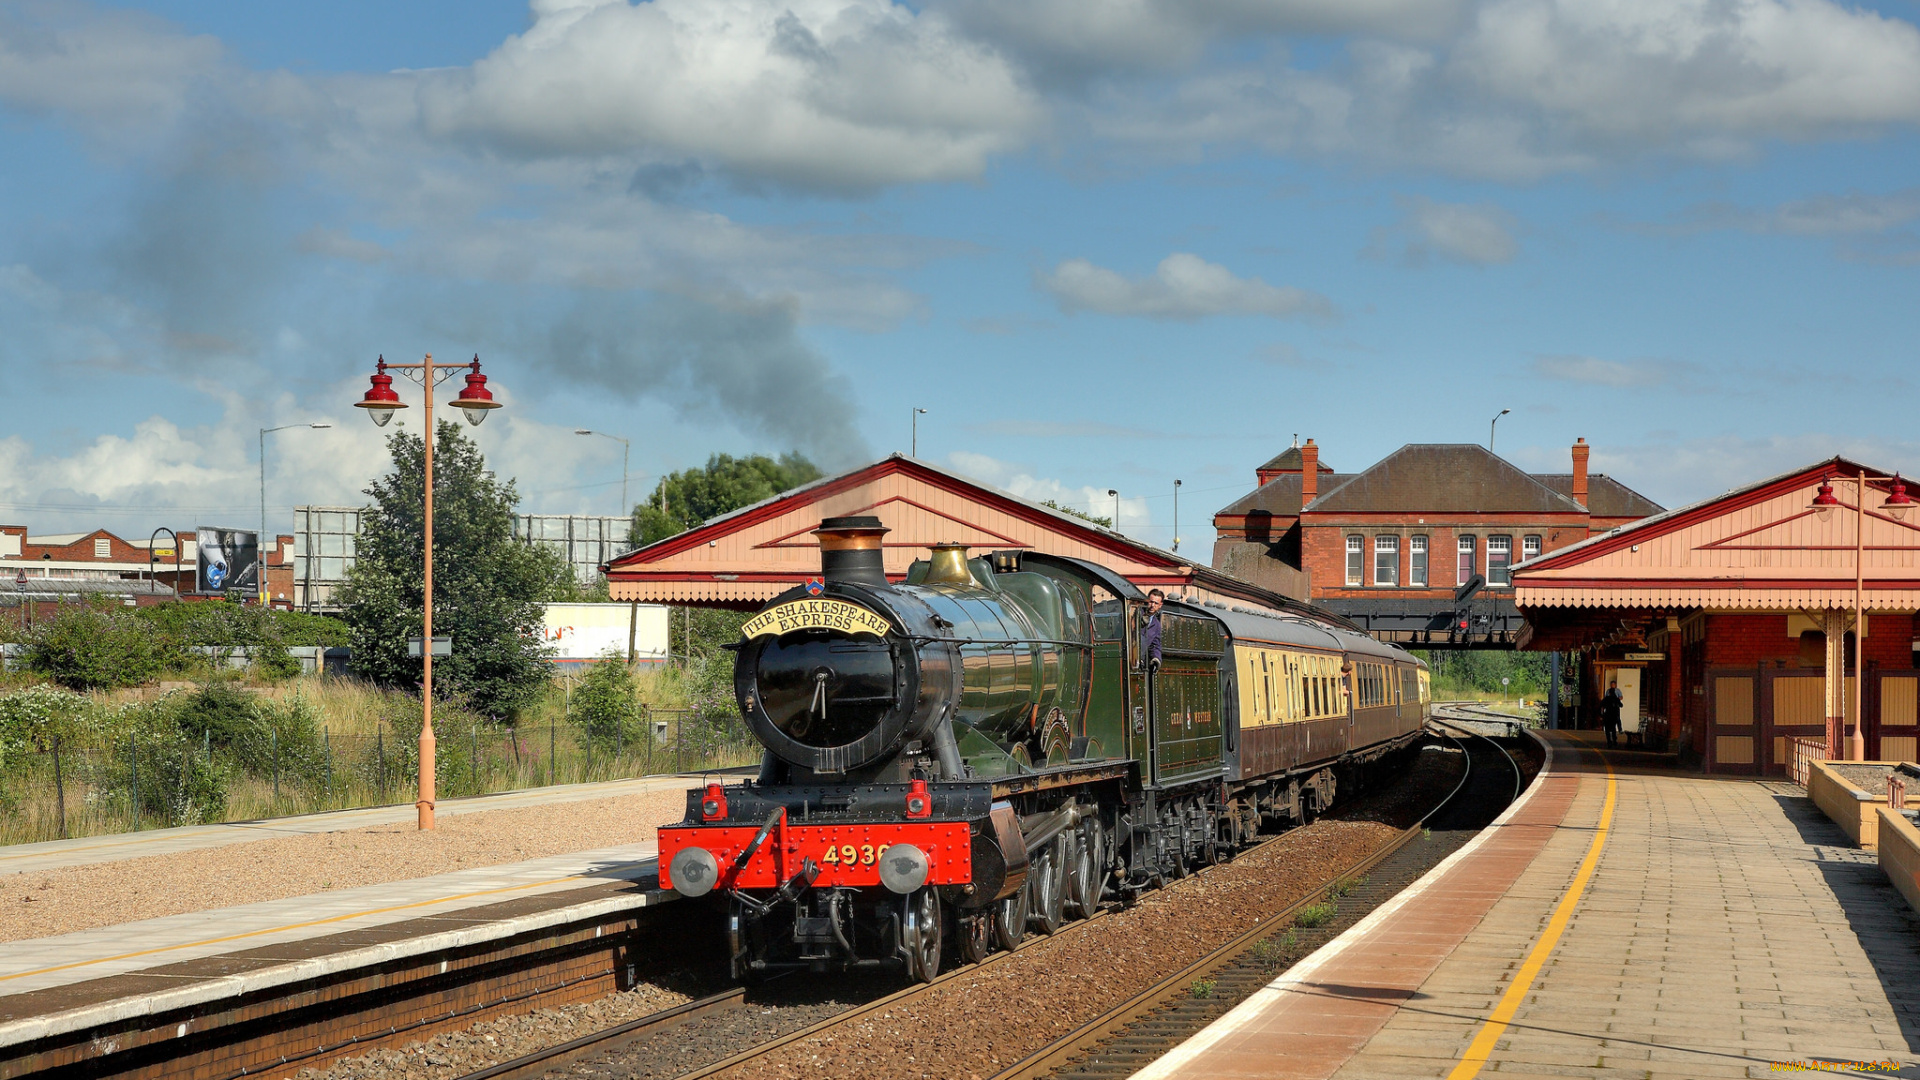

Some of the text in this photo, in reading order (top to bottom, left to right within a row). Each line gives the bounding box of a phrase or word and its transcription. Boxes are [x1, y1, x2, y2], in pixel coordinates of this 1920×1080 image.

[744, 601, 887, 636] THE SHAKESPEARE
[779, 613, 852, 632] EXPRESS
[1567, 668, 1573, 676] 3
